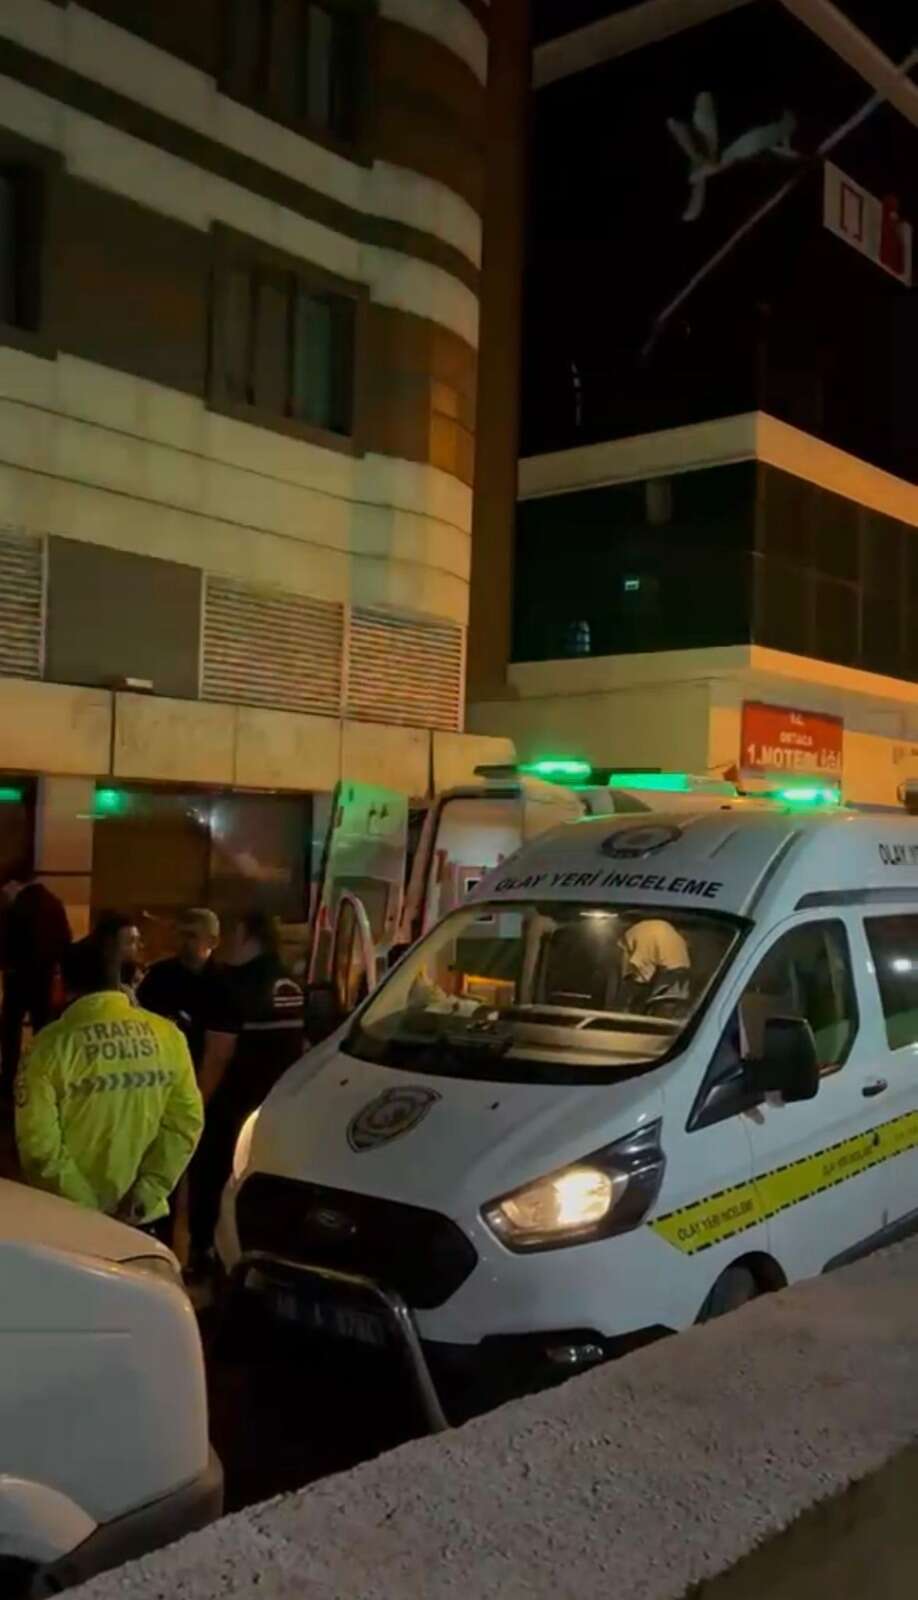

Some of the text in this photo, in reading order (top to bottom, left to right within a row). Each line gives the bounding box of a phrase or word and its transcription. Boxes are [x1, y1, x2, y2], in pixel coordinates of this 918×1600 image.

[495, 868, 723, 899] OLAY YERİ İNCELEME
